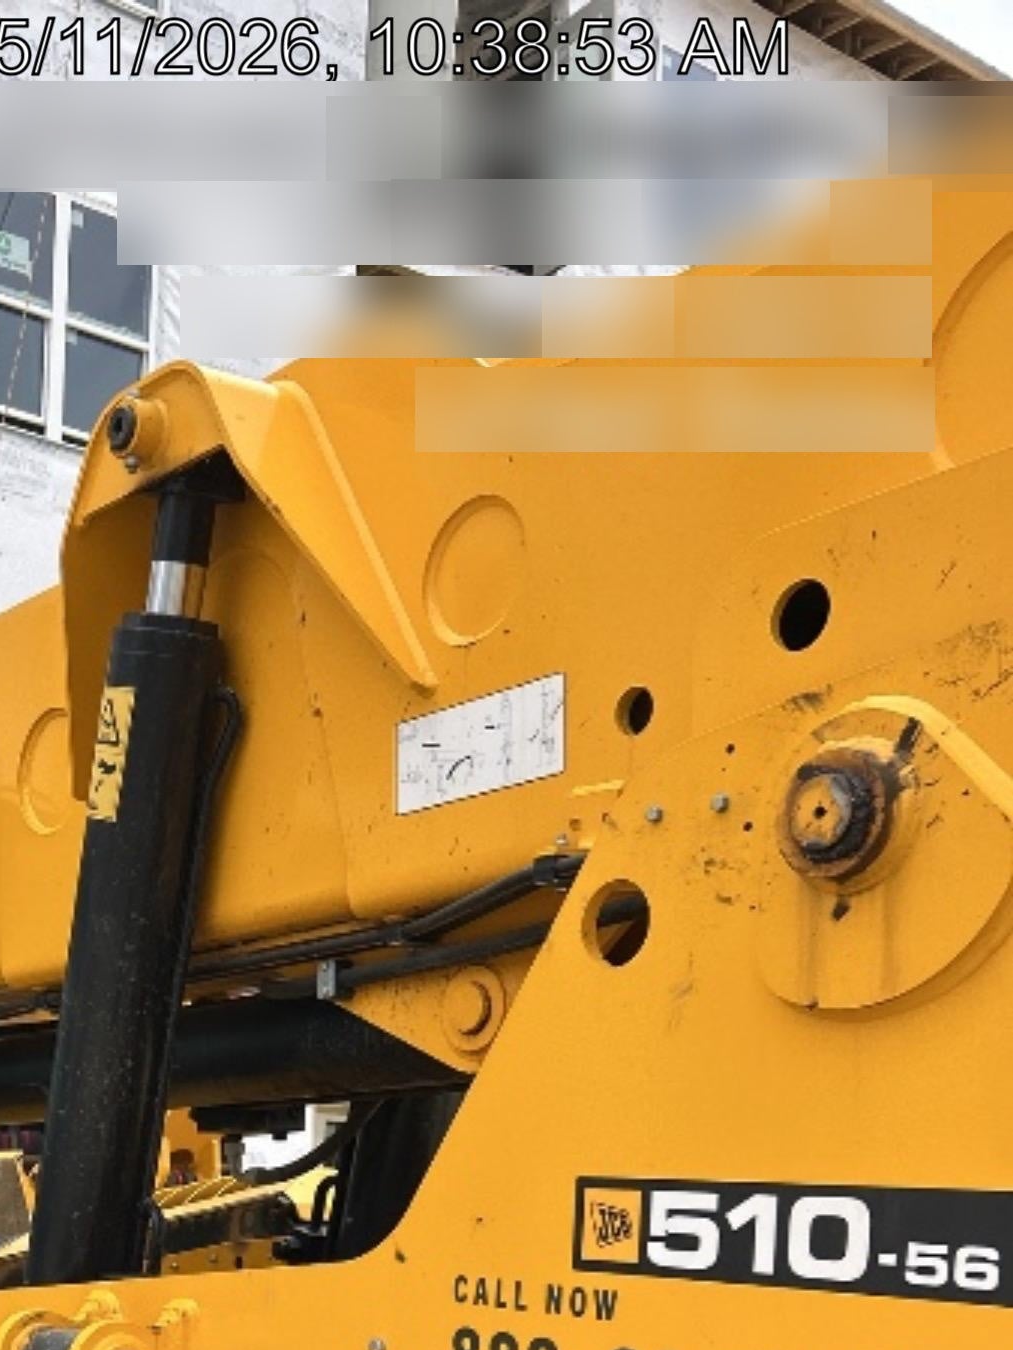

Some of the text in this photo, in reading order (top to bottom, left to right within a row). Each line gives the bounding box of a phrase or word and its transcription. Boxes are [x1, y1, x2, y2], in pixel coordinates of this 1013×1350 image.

[646, 1190, 1001, 1292] 510-56
[453, 1274, 618, 1321] CALL NOW
